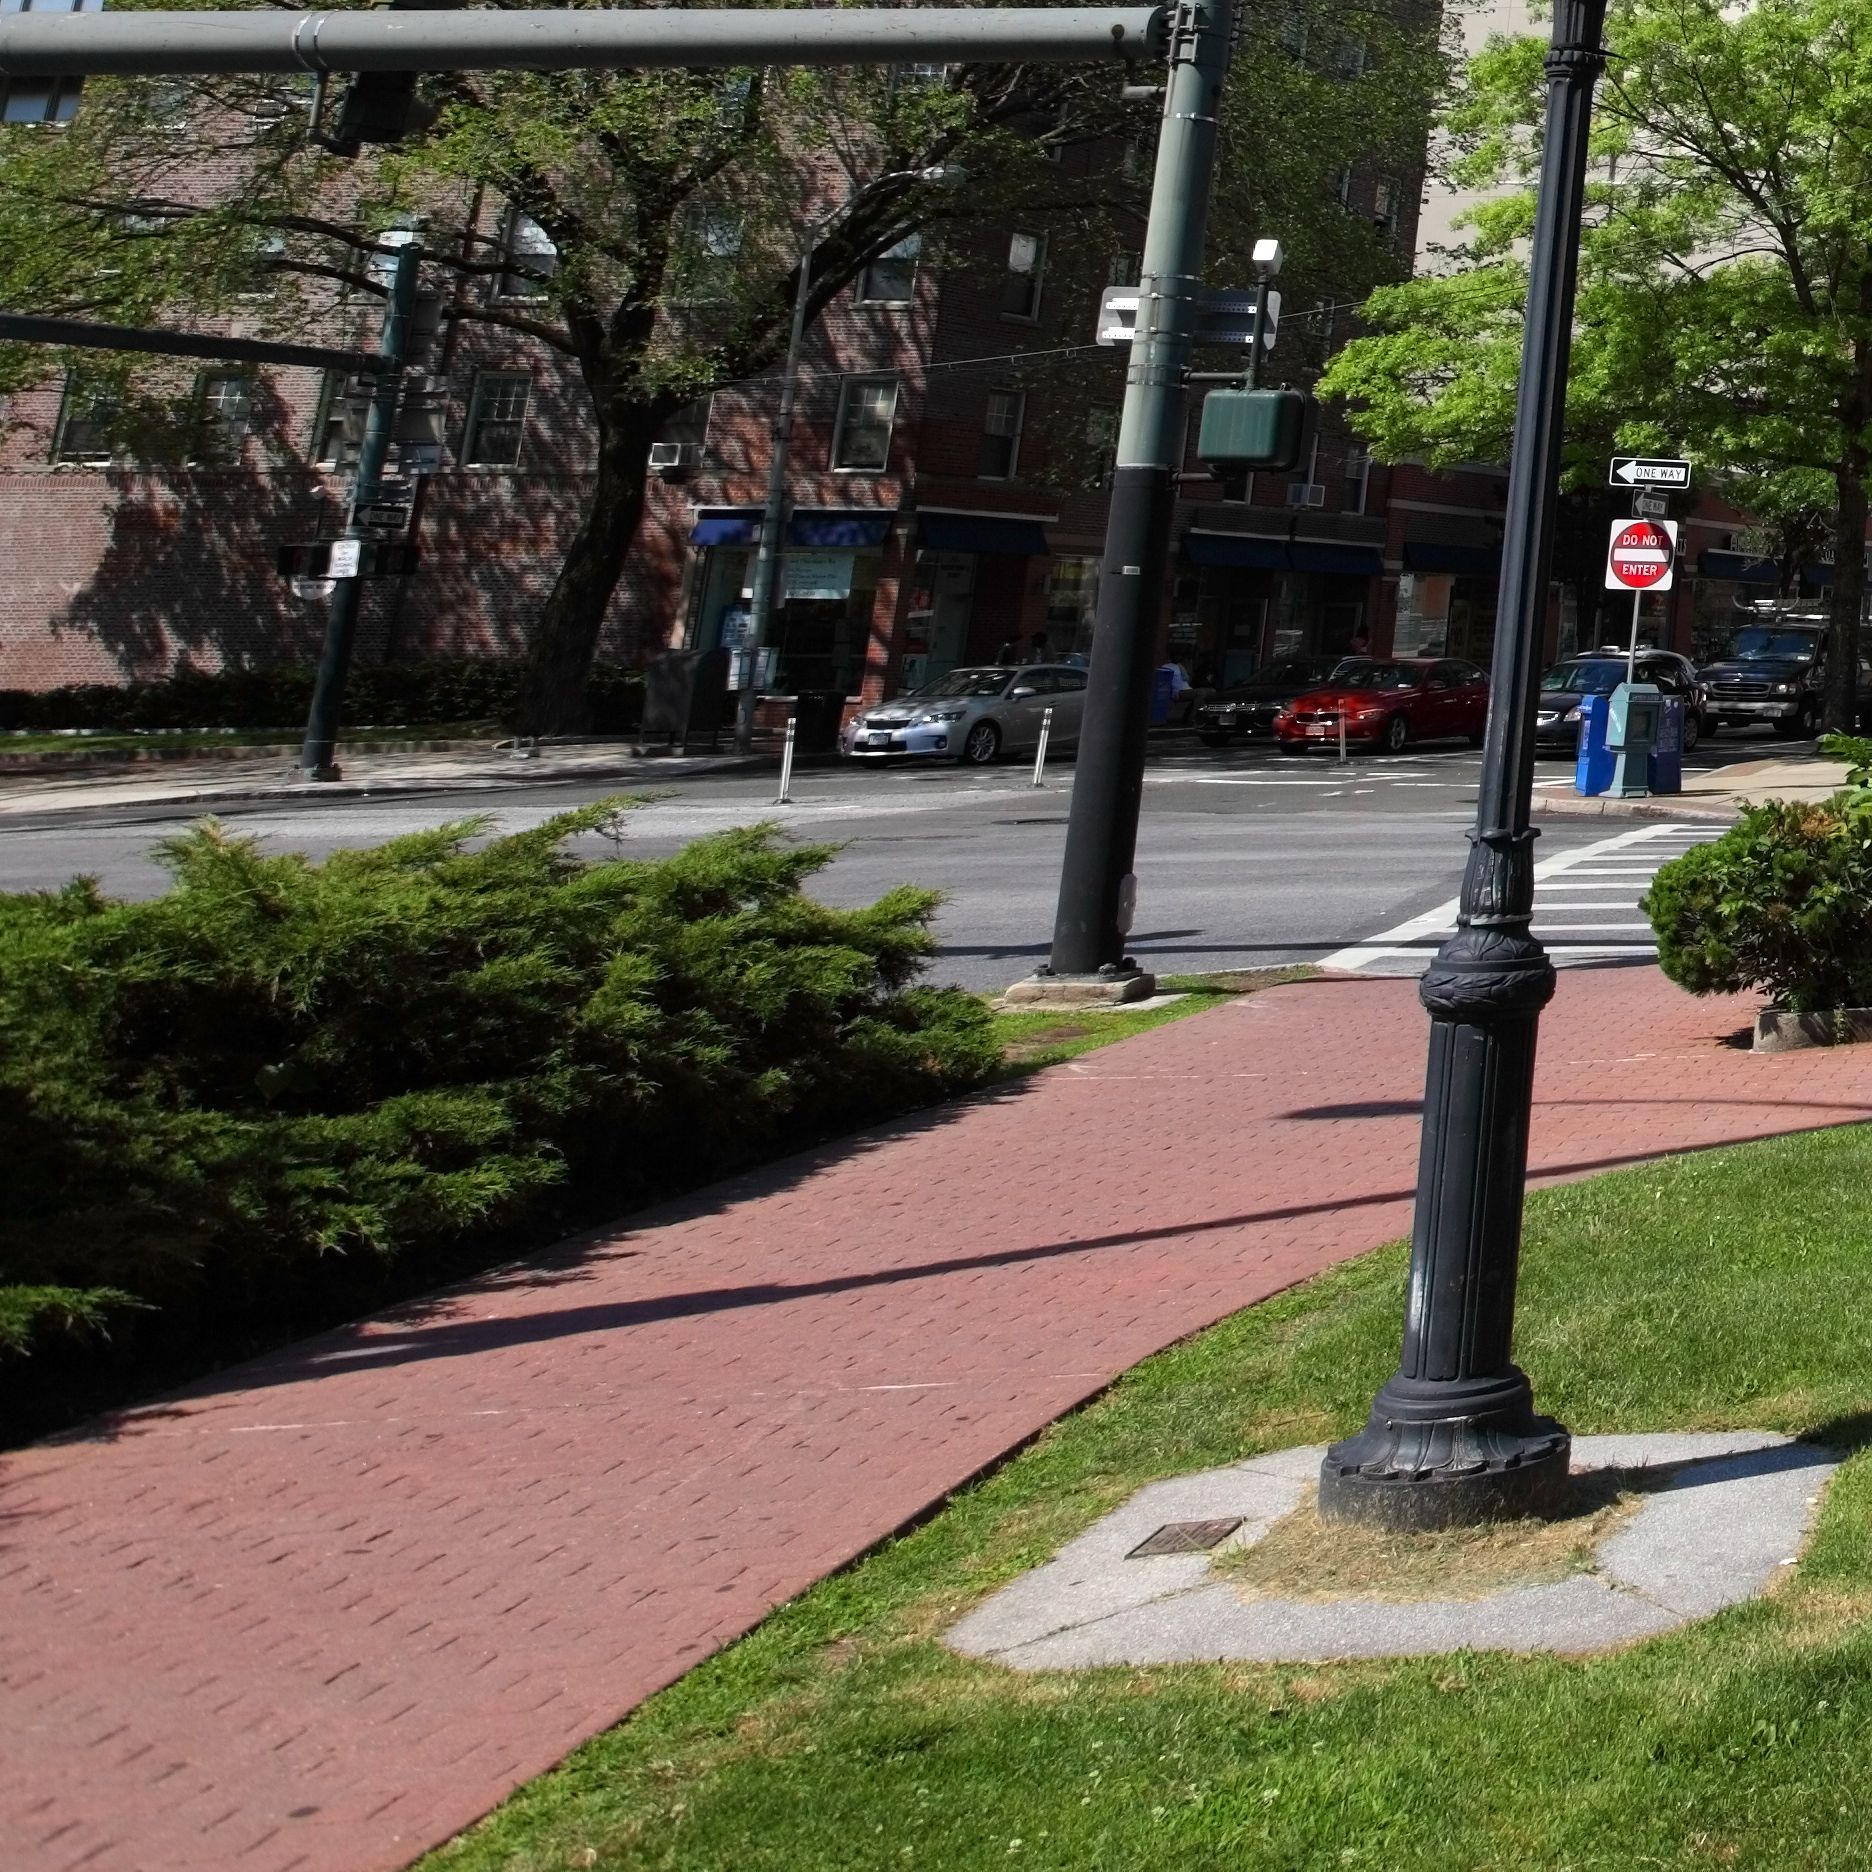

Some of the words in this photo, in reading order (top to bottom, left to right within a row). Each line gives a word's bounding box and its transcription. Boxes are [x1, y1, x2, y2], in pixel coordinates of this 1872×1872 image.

[1636, 467, 1657, 478] ONE
[1660, 468, 1683, 480] WAY
[1642, 499, 1654, 511] ONE
[1622, 534, 1639, 546] DO
[1642, 535, 1664, 546] NOT
[1622, 563, 1658, 576] ENTER
